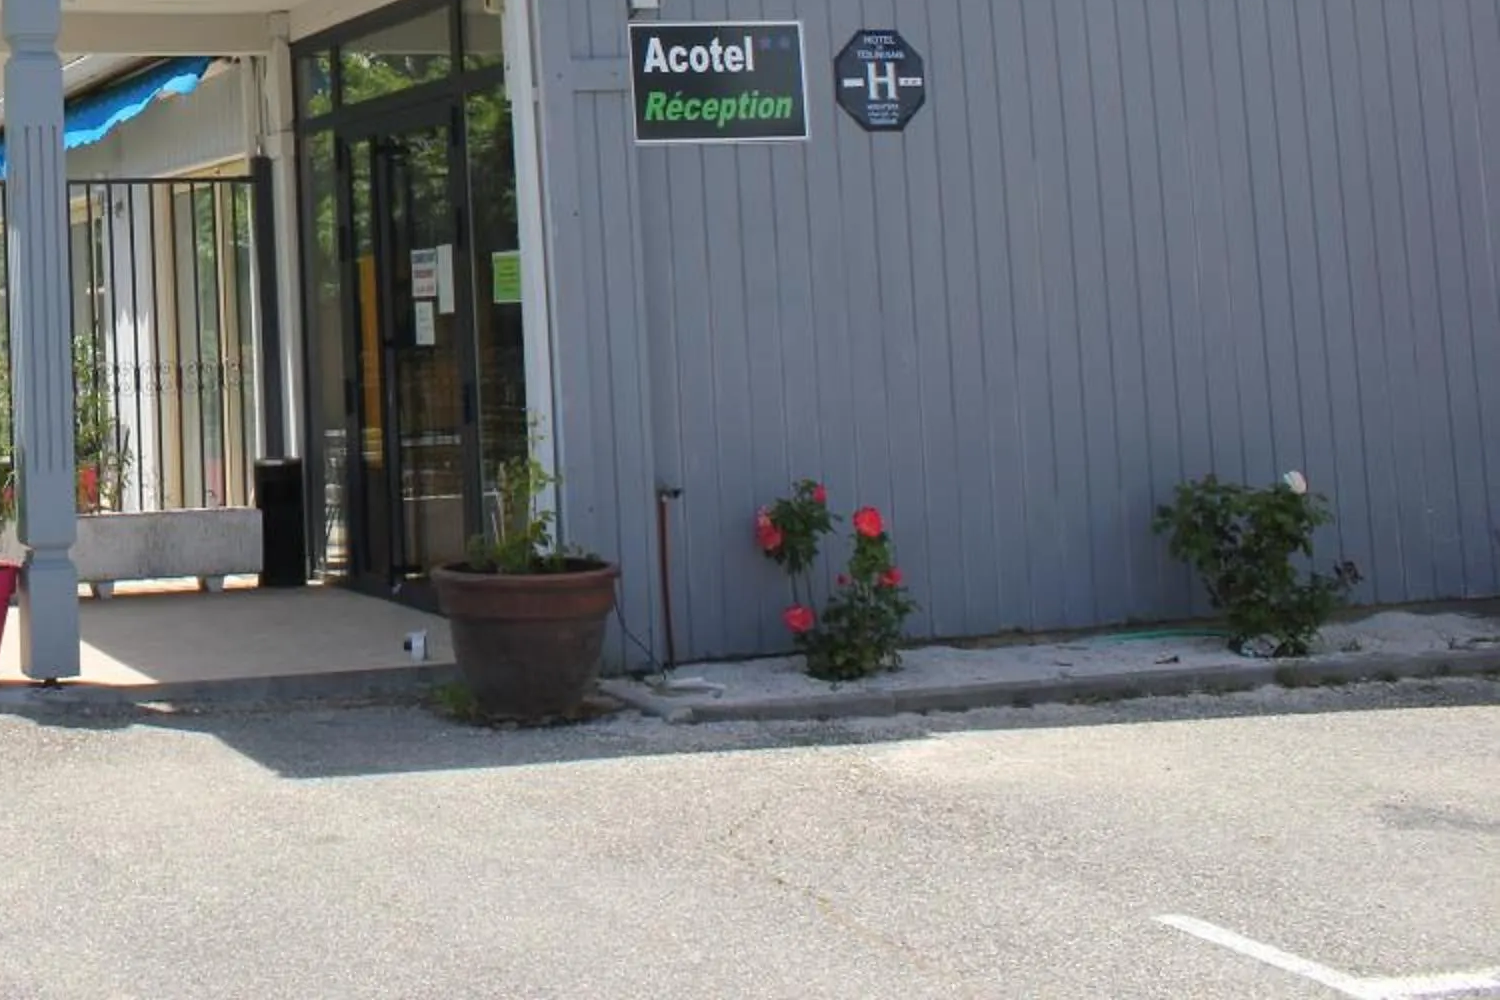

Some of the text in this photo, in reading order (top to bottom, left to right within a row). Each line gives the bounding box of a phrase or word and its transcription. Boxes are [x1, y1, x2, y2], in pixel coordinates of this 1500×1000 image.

[643, 35, 755, 73] Acotel
[867, 61, 898, 100] H
[644, 90, 793, 128] Réception
